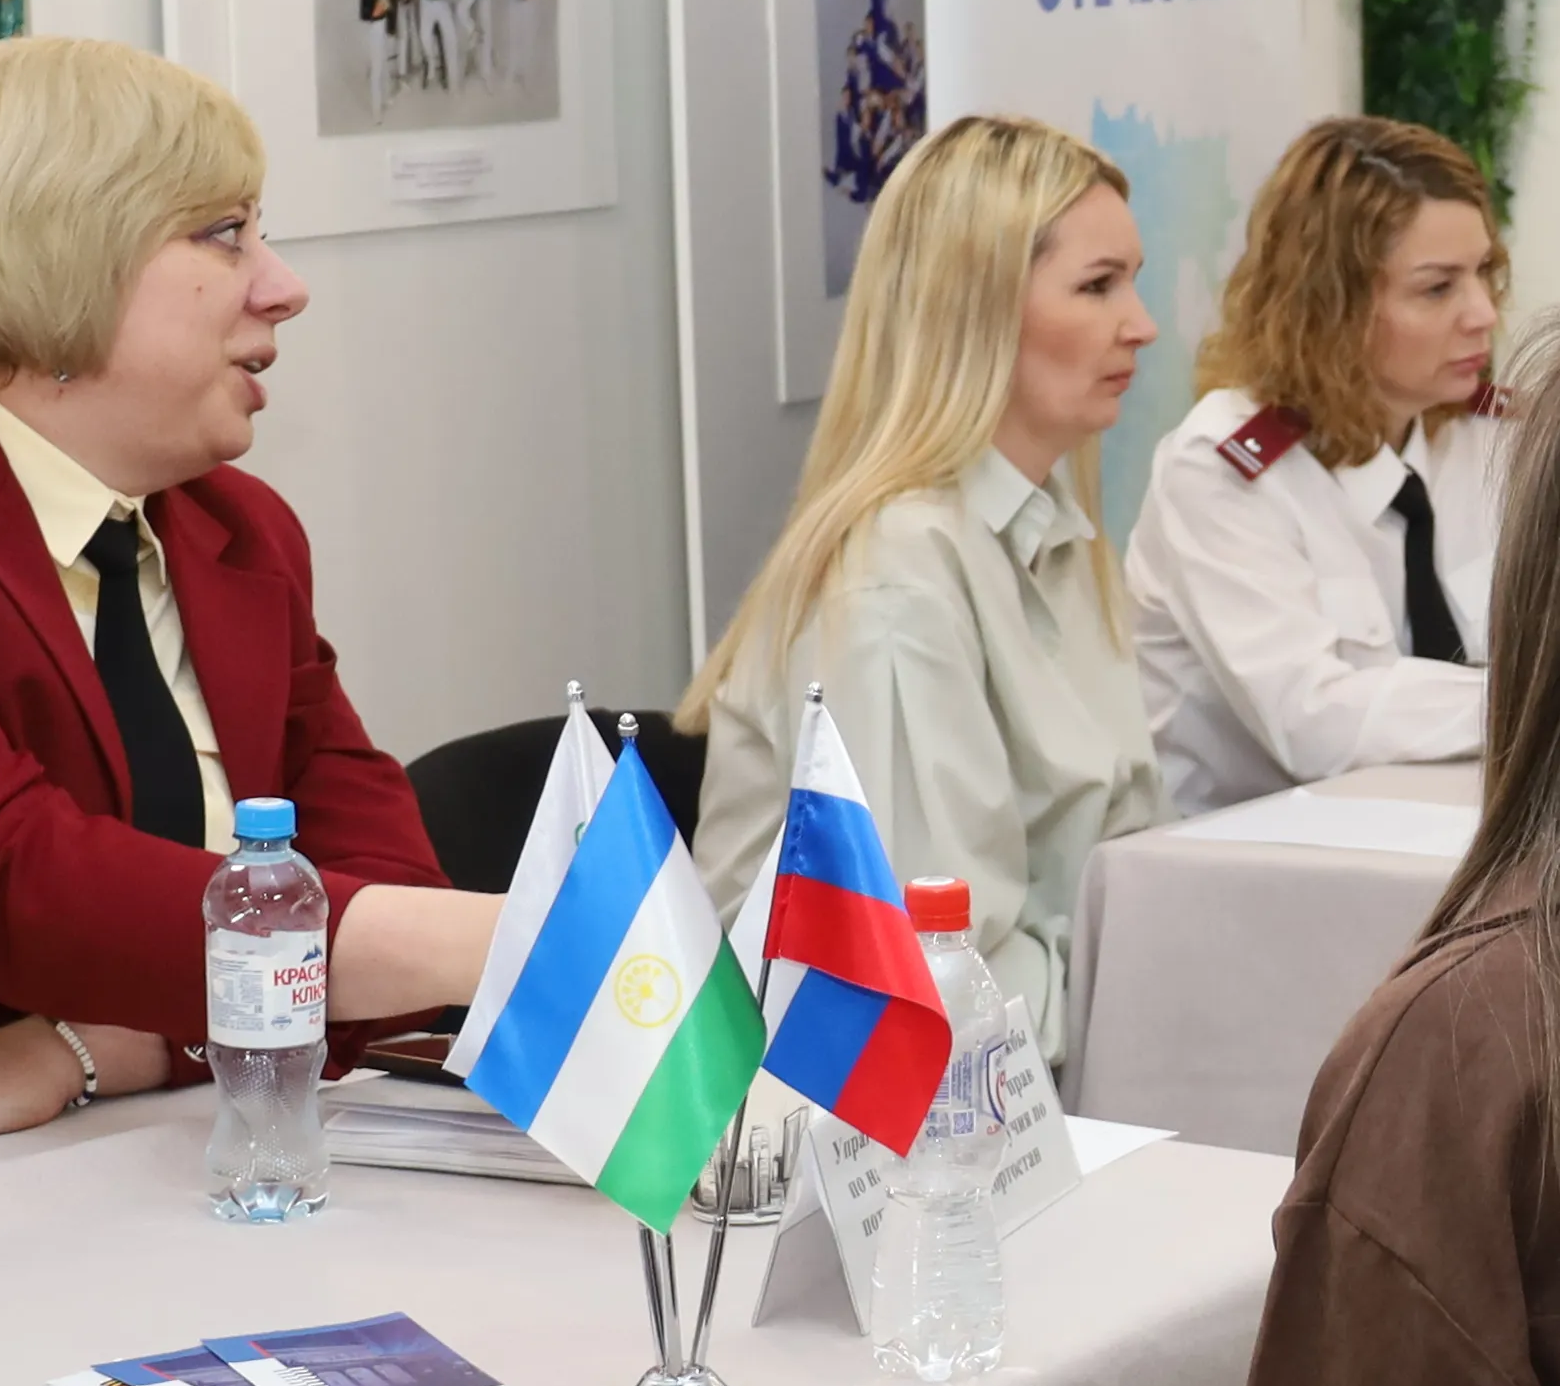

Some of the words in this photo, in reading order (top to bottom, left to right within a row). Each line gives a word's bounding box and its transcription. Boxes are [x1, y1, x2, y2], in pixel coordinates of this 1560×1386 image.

[273, 962, 327, 987] КРАСН
[292, 982, 327, 1006] КЛЮ
[1032, 1101, 1047, 1122] по
[848, 1176, 867, 1199] по
[1006, 1067, 1035, 1098] прав
